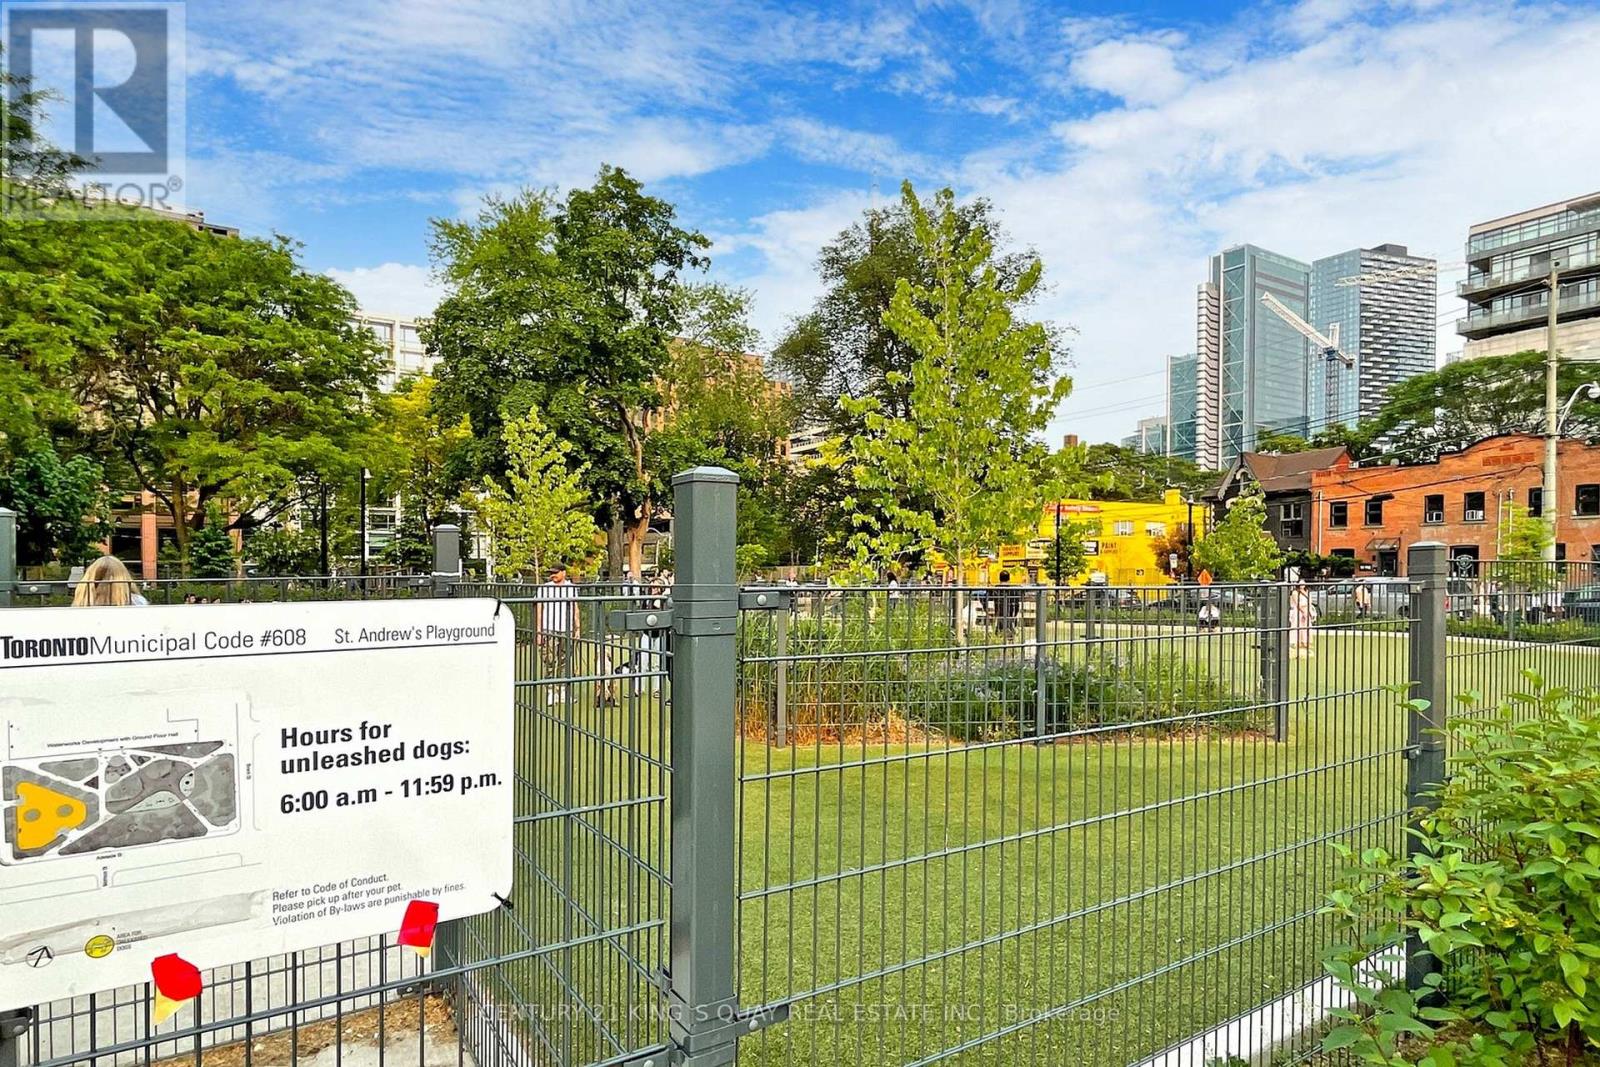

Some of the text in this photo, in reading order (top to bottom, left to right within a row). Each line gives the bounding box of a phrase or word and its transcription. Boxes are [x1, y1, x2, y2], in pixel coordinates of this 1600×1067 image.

[90, 632, 197, 656] Municipal
[204, 630, 254, 650] Code
[260, 628, 307, 647] #608
[334, 622, 496, 644] St. Andrew's Playground
[280, 720, 392, 749] Hours for
[280, 741, 405, 775] unleashed
[412, 739, 470, 761] dogs:
[280, 789, 329, 814] 6:00
[336, 787, 377, 807] a.m
[400, 773, 455, 798] 11:59
[460, 772, 502, 795] p.m.
[272, 889, 298, 902] Refer
[301, 888, 310, 896] to
[313, 882, 337, 894] Code
[339, 878, 349, 890] of
[272, 901, 305, 914] Please
[306, 896, 326, 909] pick
[328, 894, 340, 904] up
[341, 890, 363, 902] after
[365, 886, 384, 898] your
[272, 912, 315, 926] Violation
[317, 906, 327, 918] of
[329, 902, 365, 916] By-laws
[367, 899, 382, 908] are
[384, 888, 430, 907] punishable
[432, 886, 442, 897] by
